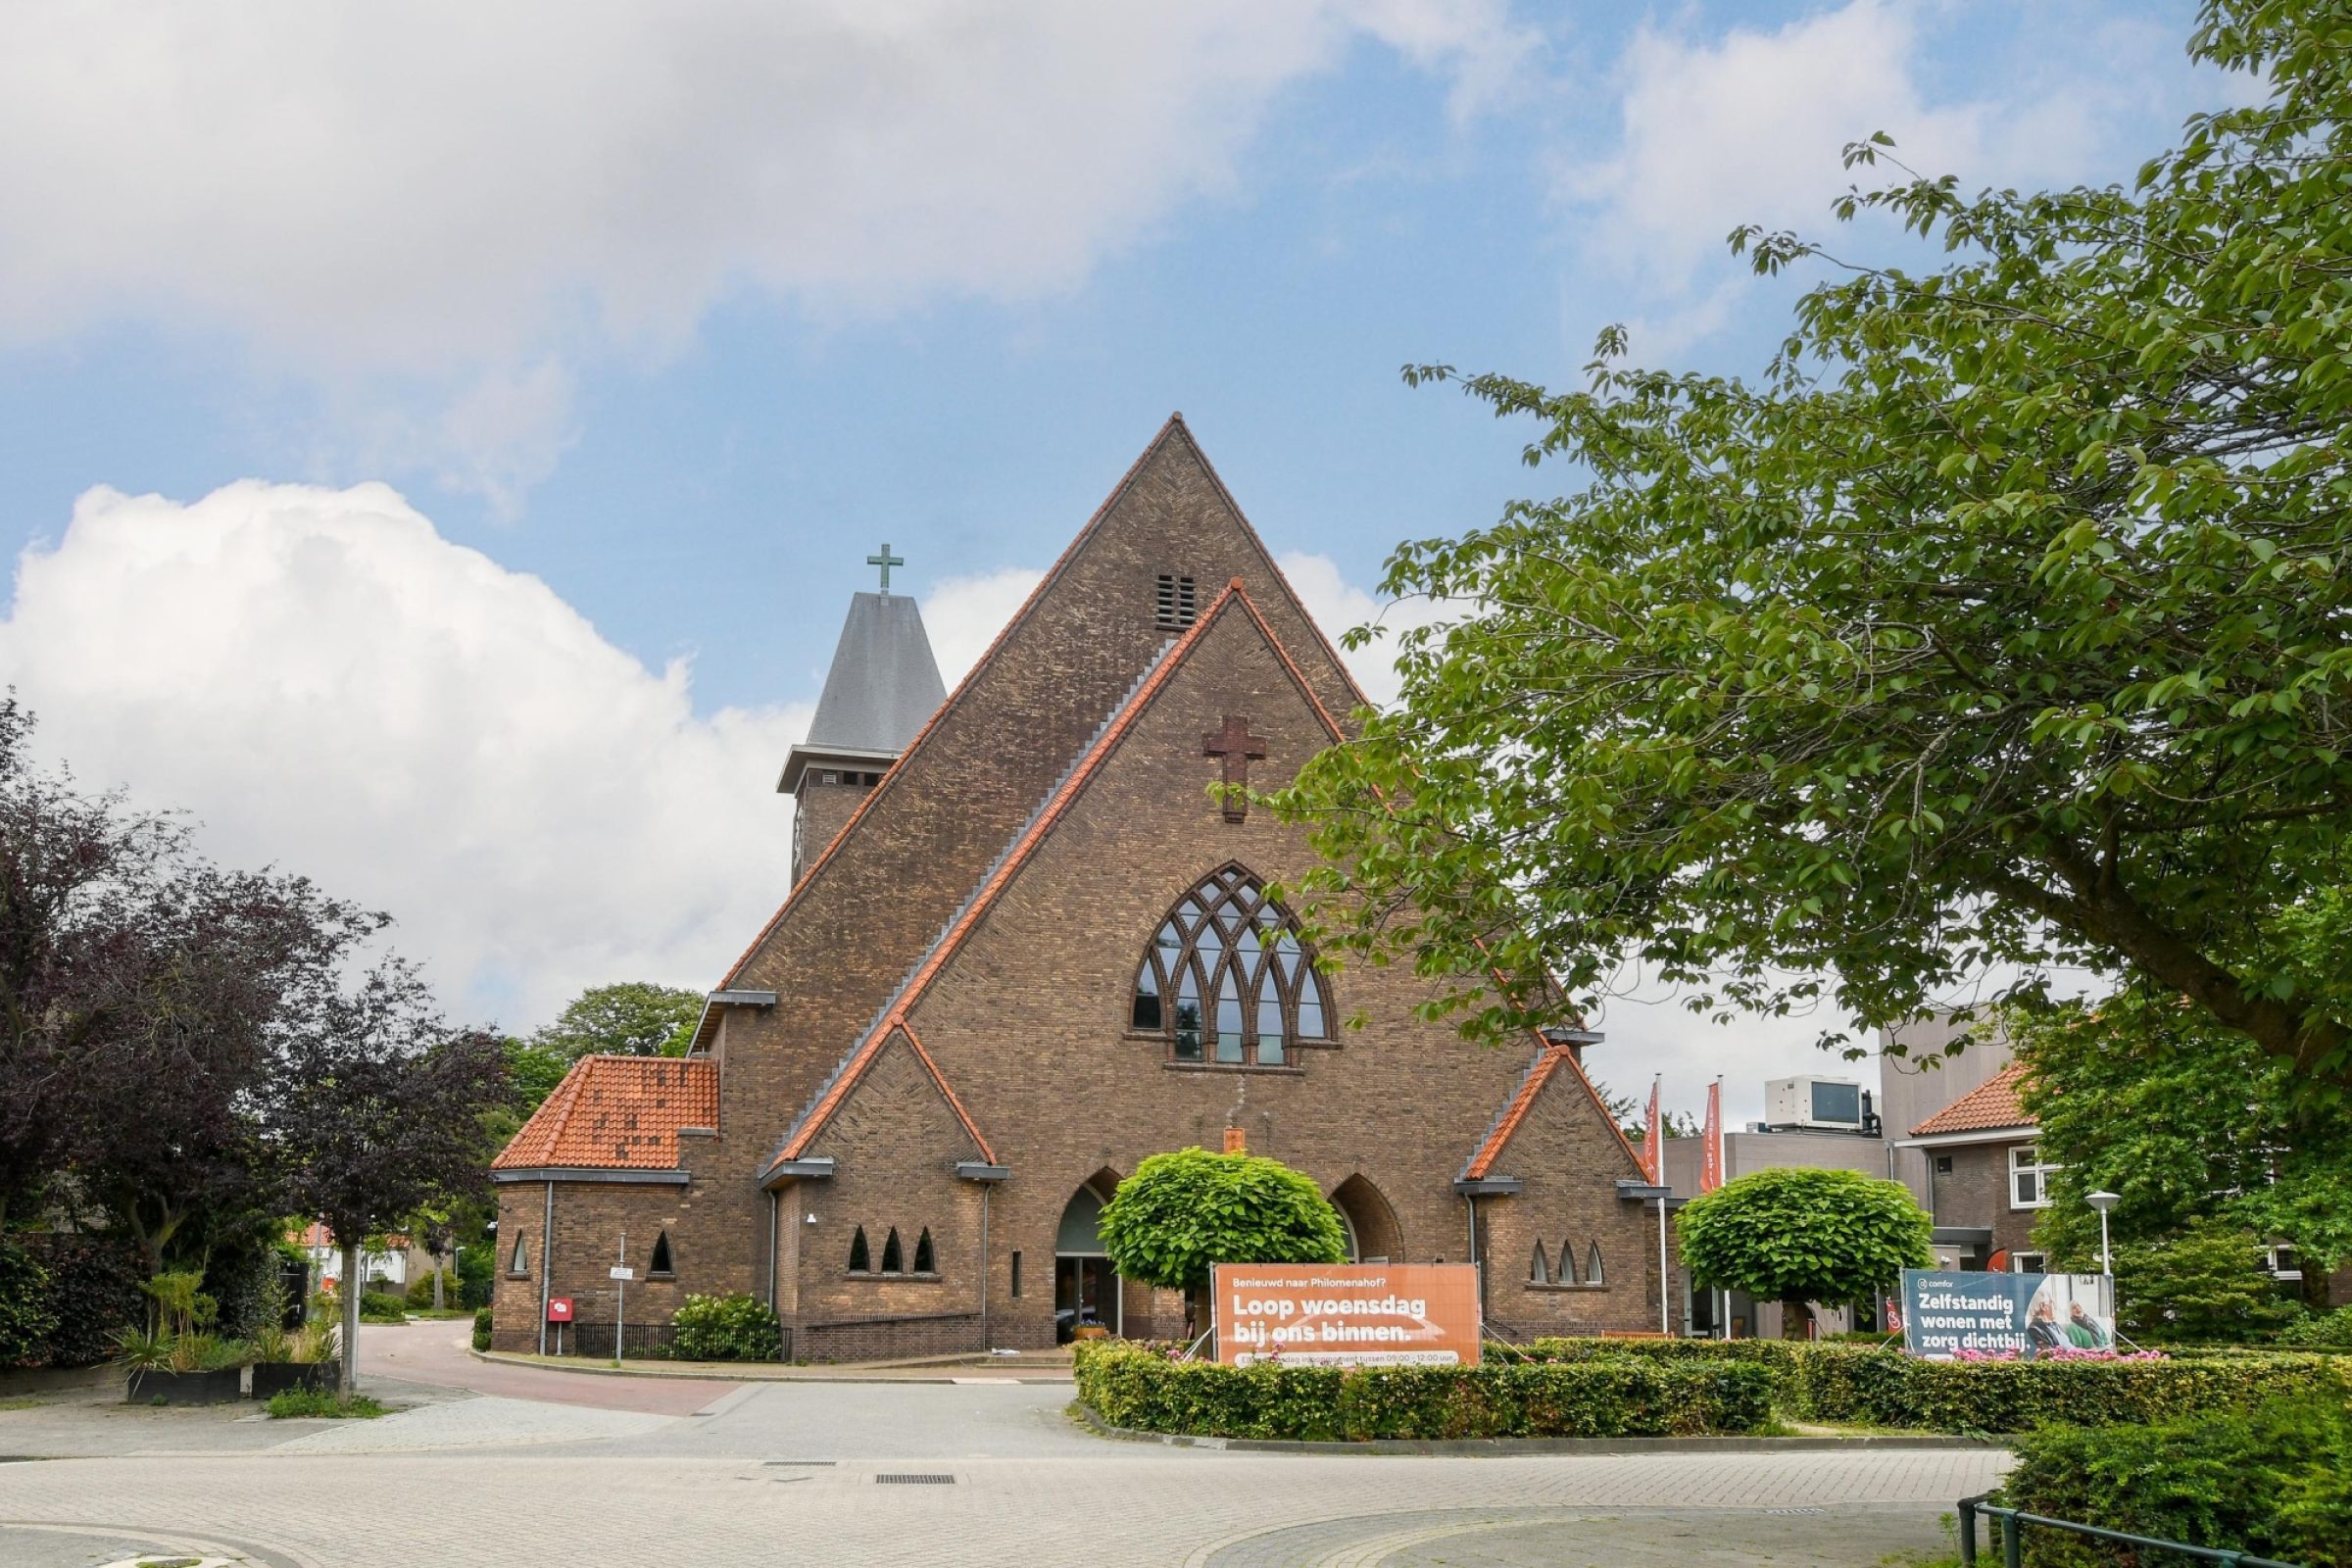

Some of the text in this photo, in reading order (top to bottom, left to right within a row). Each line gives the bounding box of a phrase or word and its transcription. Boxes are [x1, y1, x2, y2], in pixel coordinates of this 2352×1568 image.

[1233, 1277, 1386, 1288] Benieuwd naar Philomenahof?
[1233, 1295, 1426, 1320] Loop woensdag
[1919, 1294, 2014, 1314] Zelfstandig
[1921, 1315, 2013, 1329] wonen met
[1234, 1321, 1412, 1348] bij ons binnen.
[1922, 1333, 2031, 1351] zorg dichtbij.
